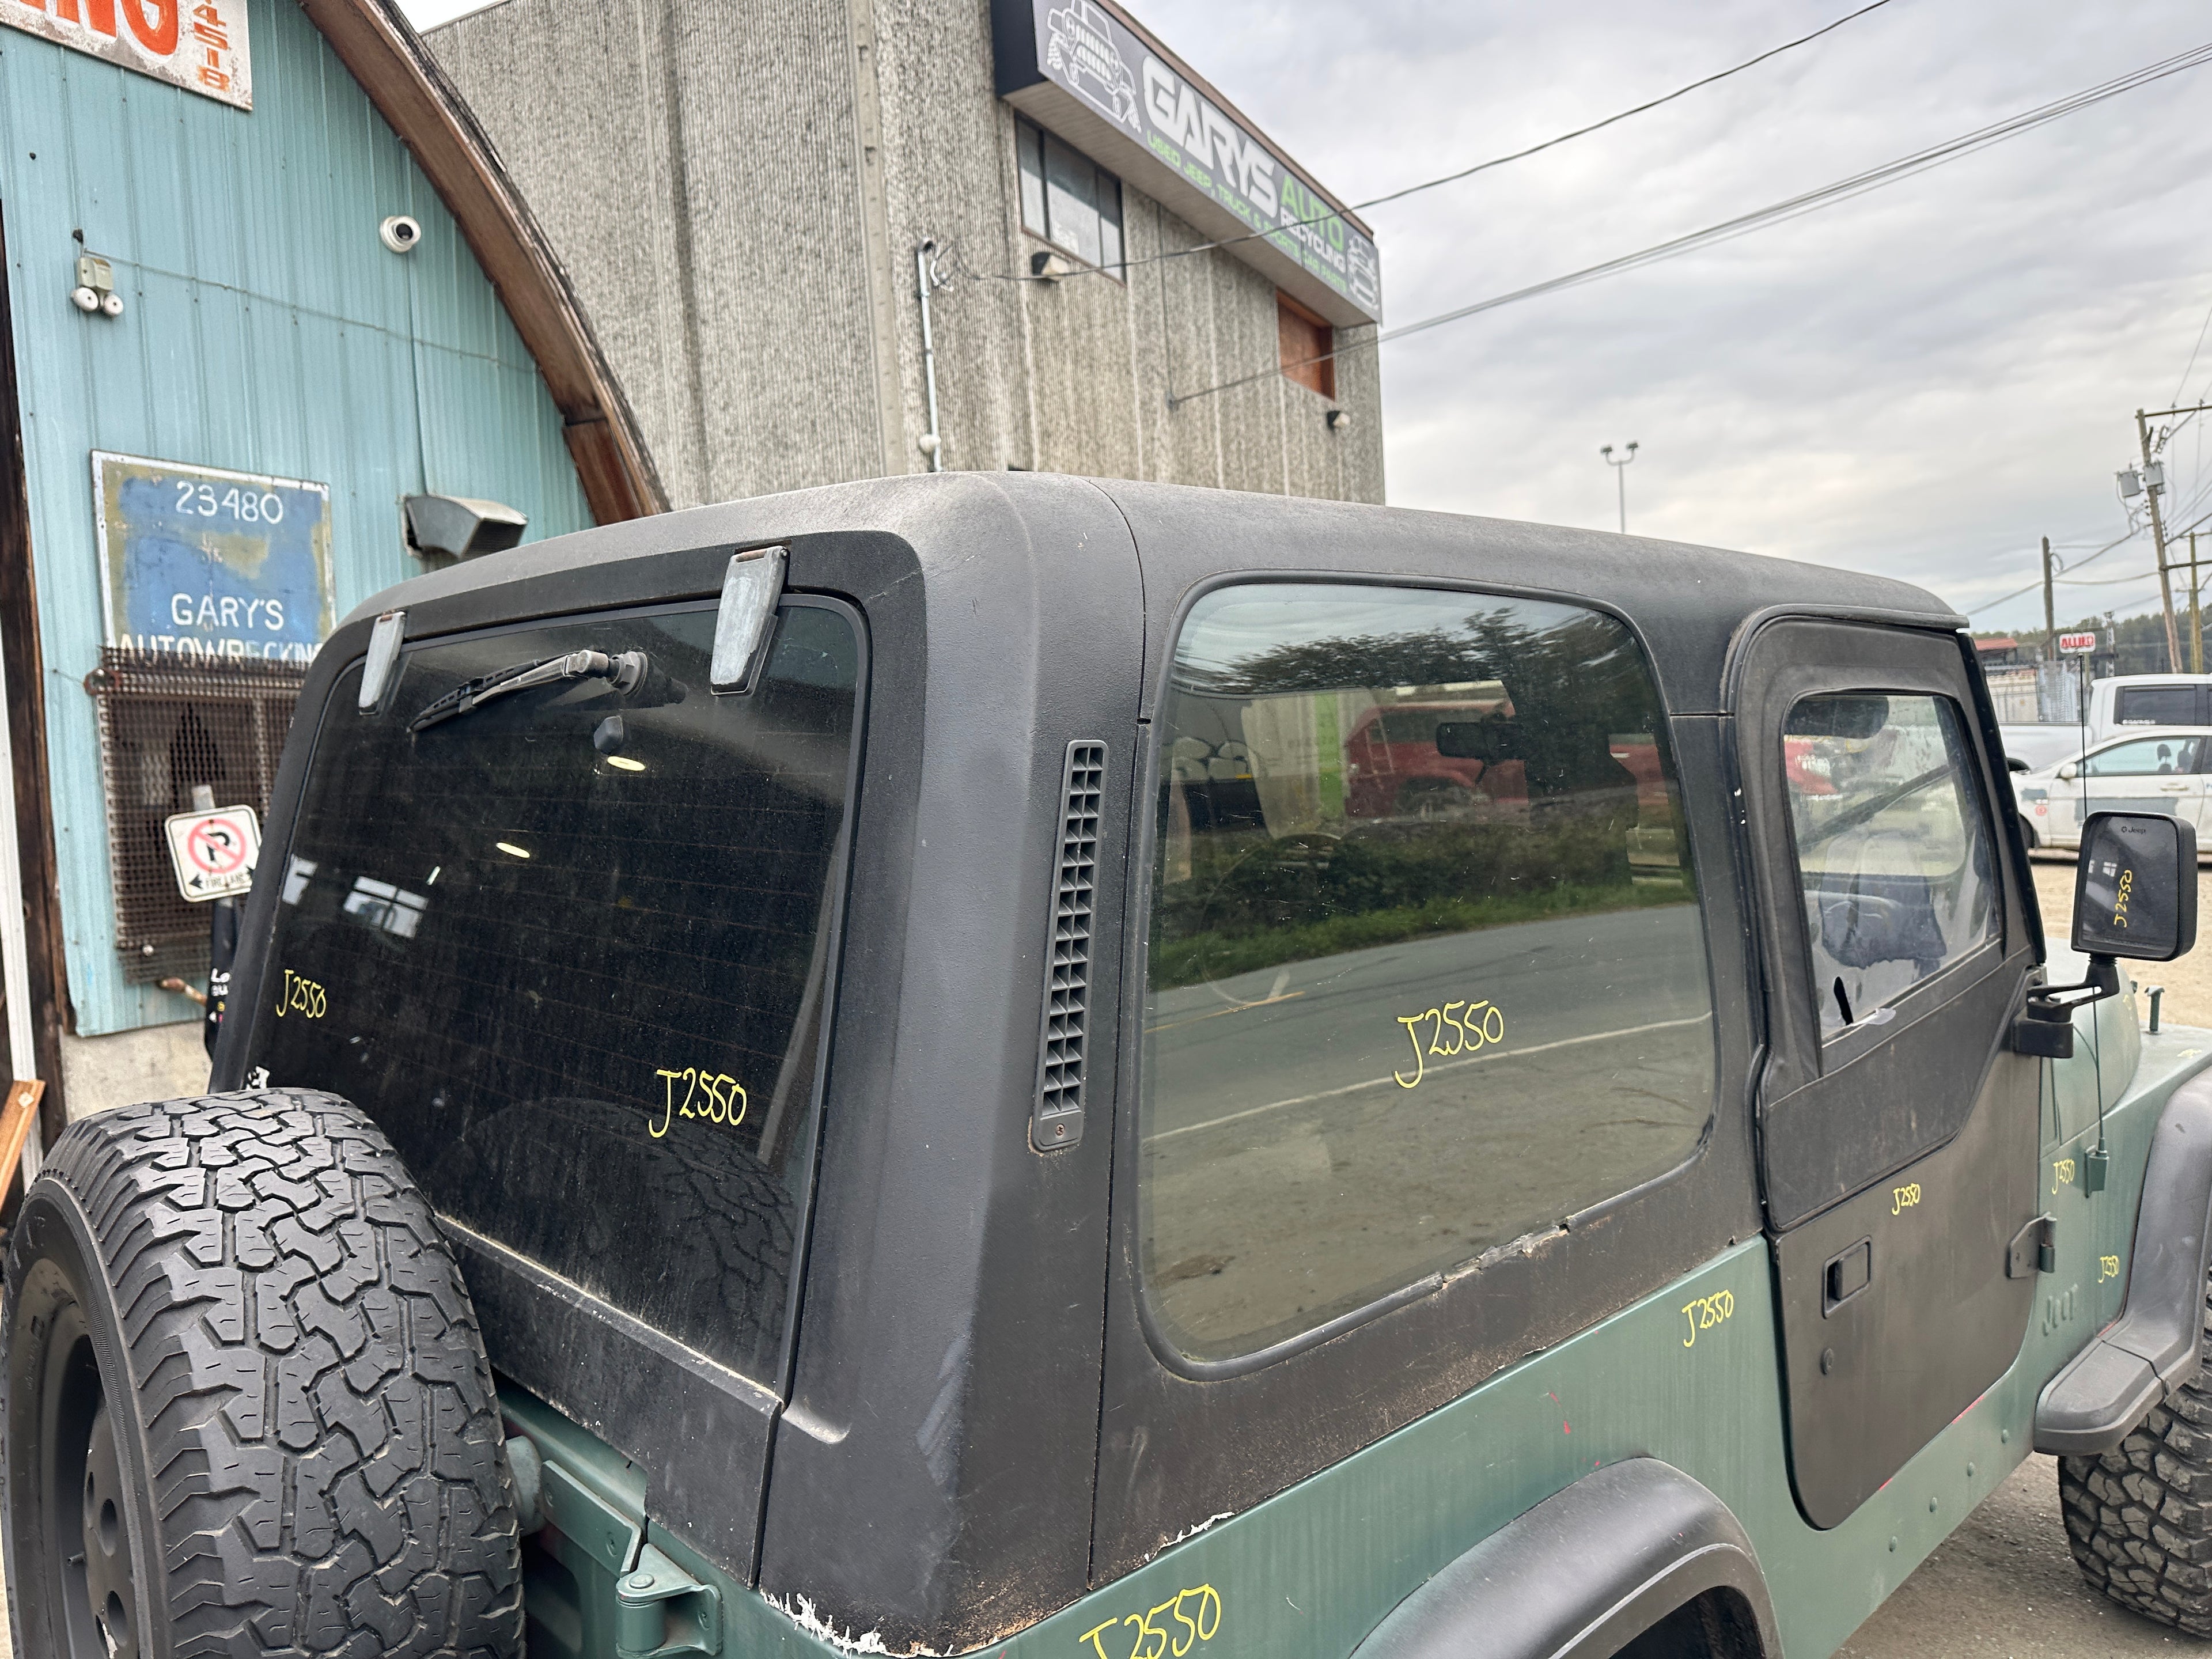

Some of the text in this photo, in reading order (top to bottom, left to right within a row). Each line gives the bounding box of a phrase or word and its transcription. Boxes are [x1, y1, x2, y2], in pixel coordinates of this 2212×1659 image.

[1142, 56, 1278, 218] GARYS
[1280, 206, 1346, 274] RECYCLING
[1281, 175, 1344, 252] AUTO
[176, 480, 283, 524] 23480
[171, 593, 285, 631] GARY'S
[2113, 869, 2133, 928] J2550
[276, 969, 327, 1018] J2550
[1394, 1000, 1504, 1089] J2550
[648, 1067, 747, 1138] J2550
[1892, 1182, 1921, 1215] J2550
[1681, 1289, 1734, 1348] J2550
